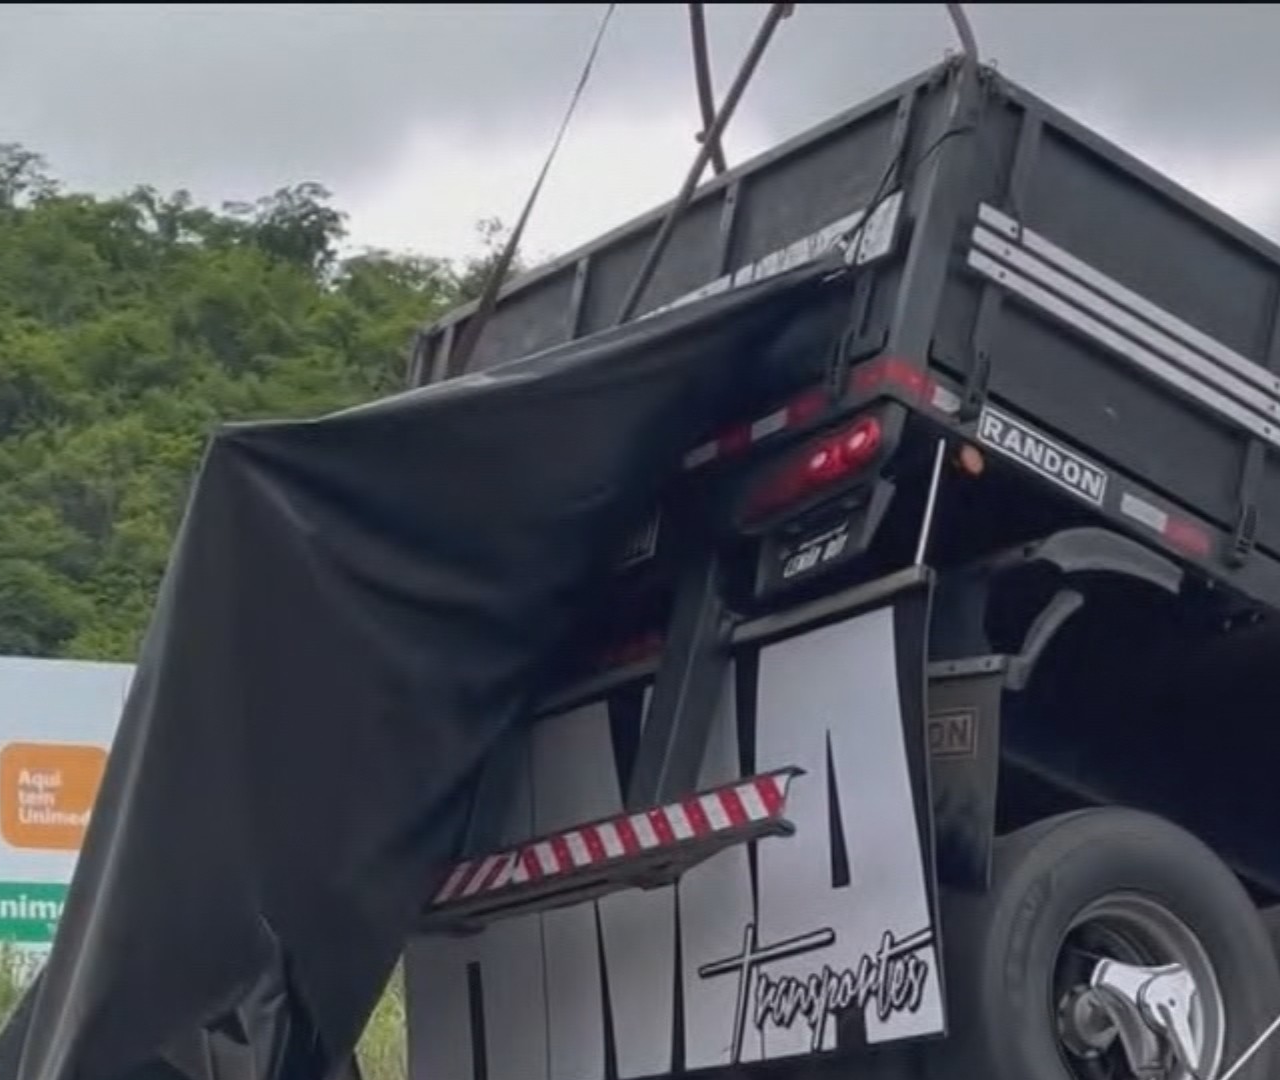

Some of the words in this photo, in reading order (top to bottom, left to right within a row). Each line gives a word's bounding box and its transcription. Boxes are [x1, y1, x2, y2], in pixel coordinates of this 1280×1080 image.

[983, 415, 1103, 497] RANDON
[19, 768, 62, 791] Aqui
[19, 791, 56, 807] tem
[698, 923, 934, 1064] Transportes
